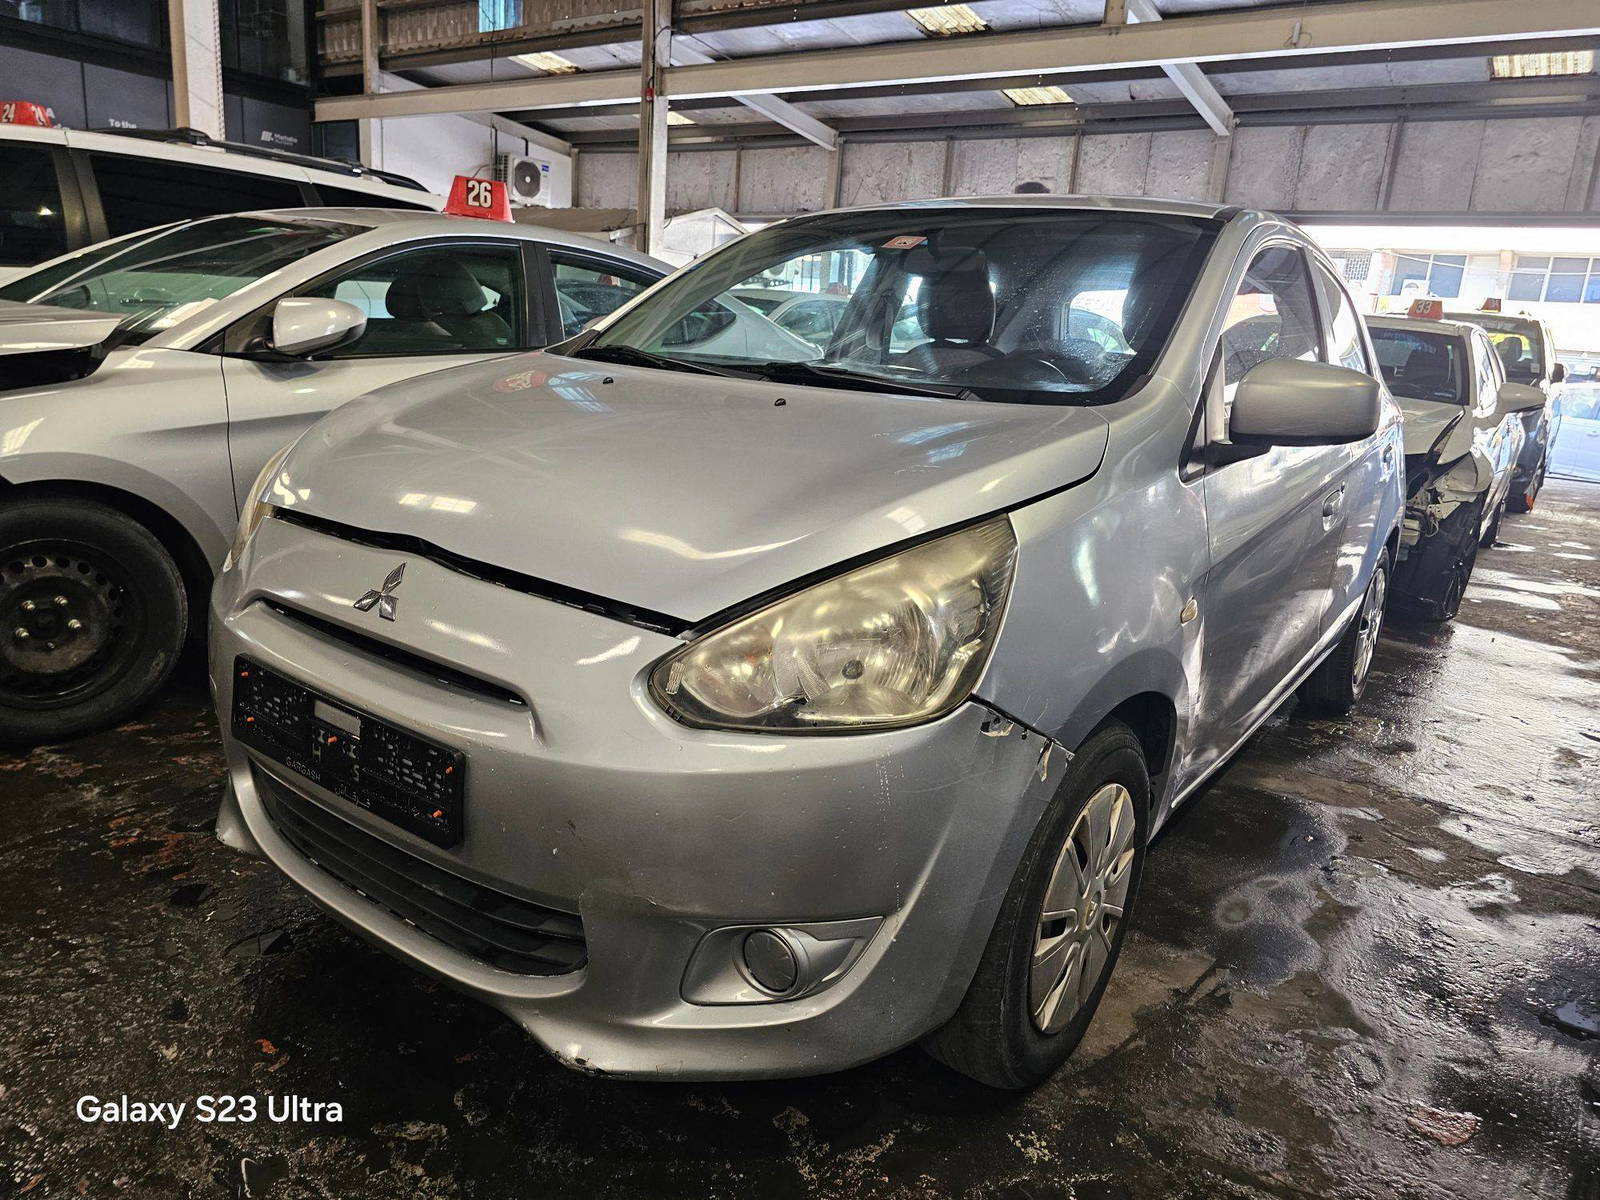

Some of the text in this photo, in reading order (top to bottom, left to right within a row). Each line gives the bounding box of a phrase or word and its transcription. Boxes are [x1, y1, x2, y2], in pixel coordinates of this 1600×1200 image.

[2, 103, 16, 122] 24
[108, 118, 120, 128] To
[467, 180, 492, 208] 26
